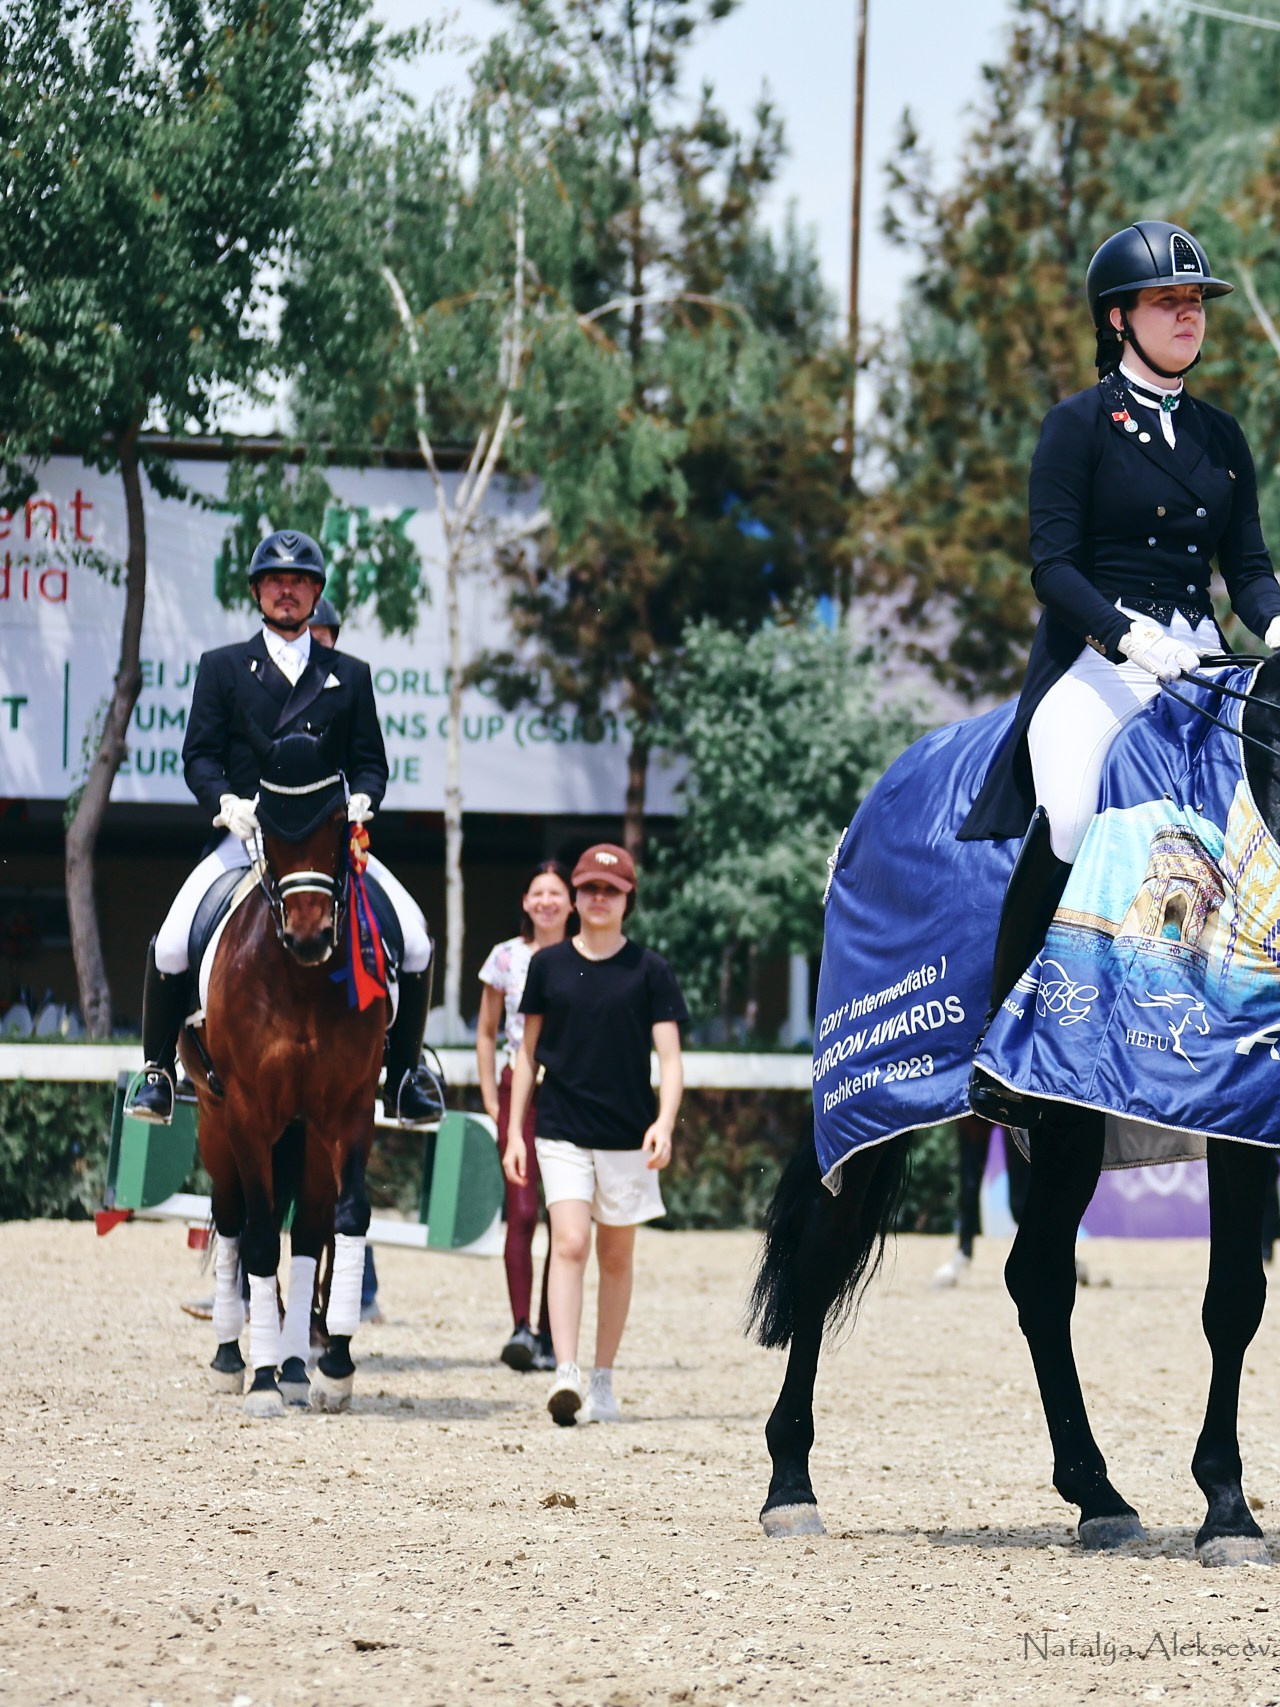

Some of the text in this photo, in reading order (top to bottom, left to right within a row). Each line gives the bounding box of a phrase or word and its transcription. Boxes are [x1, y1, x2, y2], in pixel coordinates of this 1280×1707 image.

[373, 668, 452, 697] ORL
[849, 964, 938, 1021] Intermediate
[865, 995, 966, 1050] AWARDS
[1126, 1028, 1170, 1052] HEFU
[823, 1054, 934, 1114] Tashkent 2023
